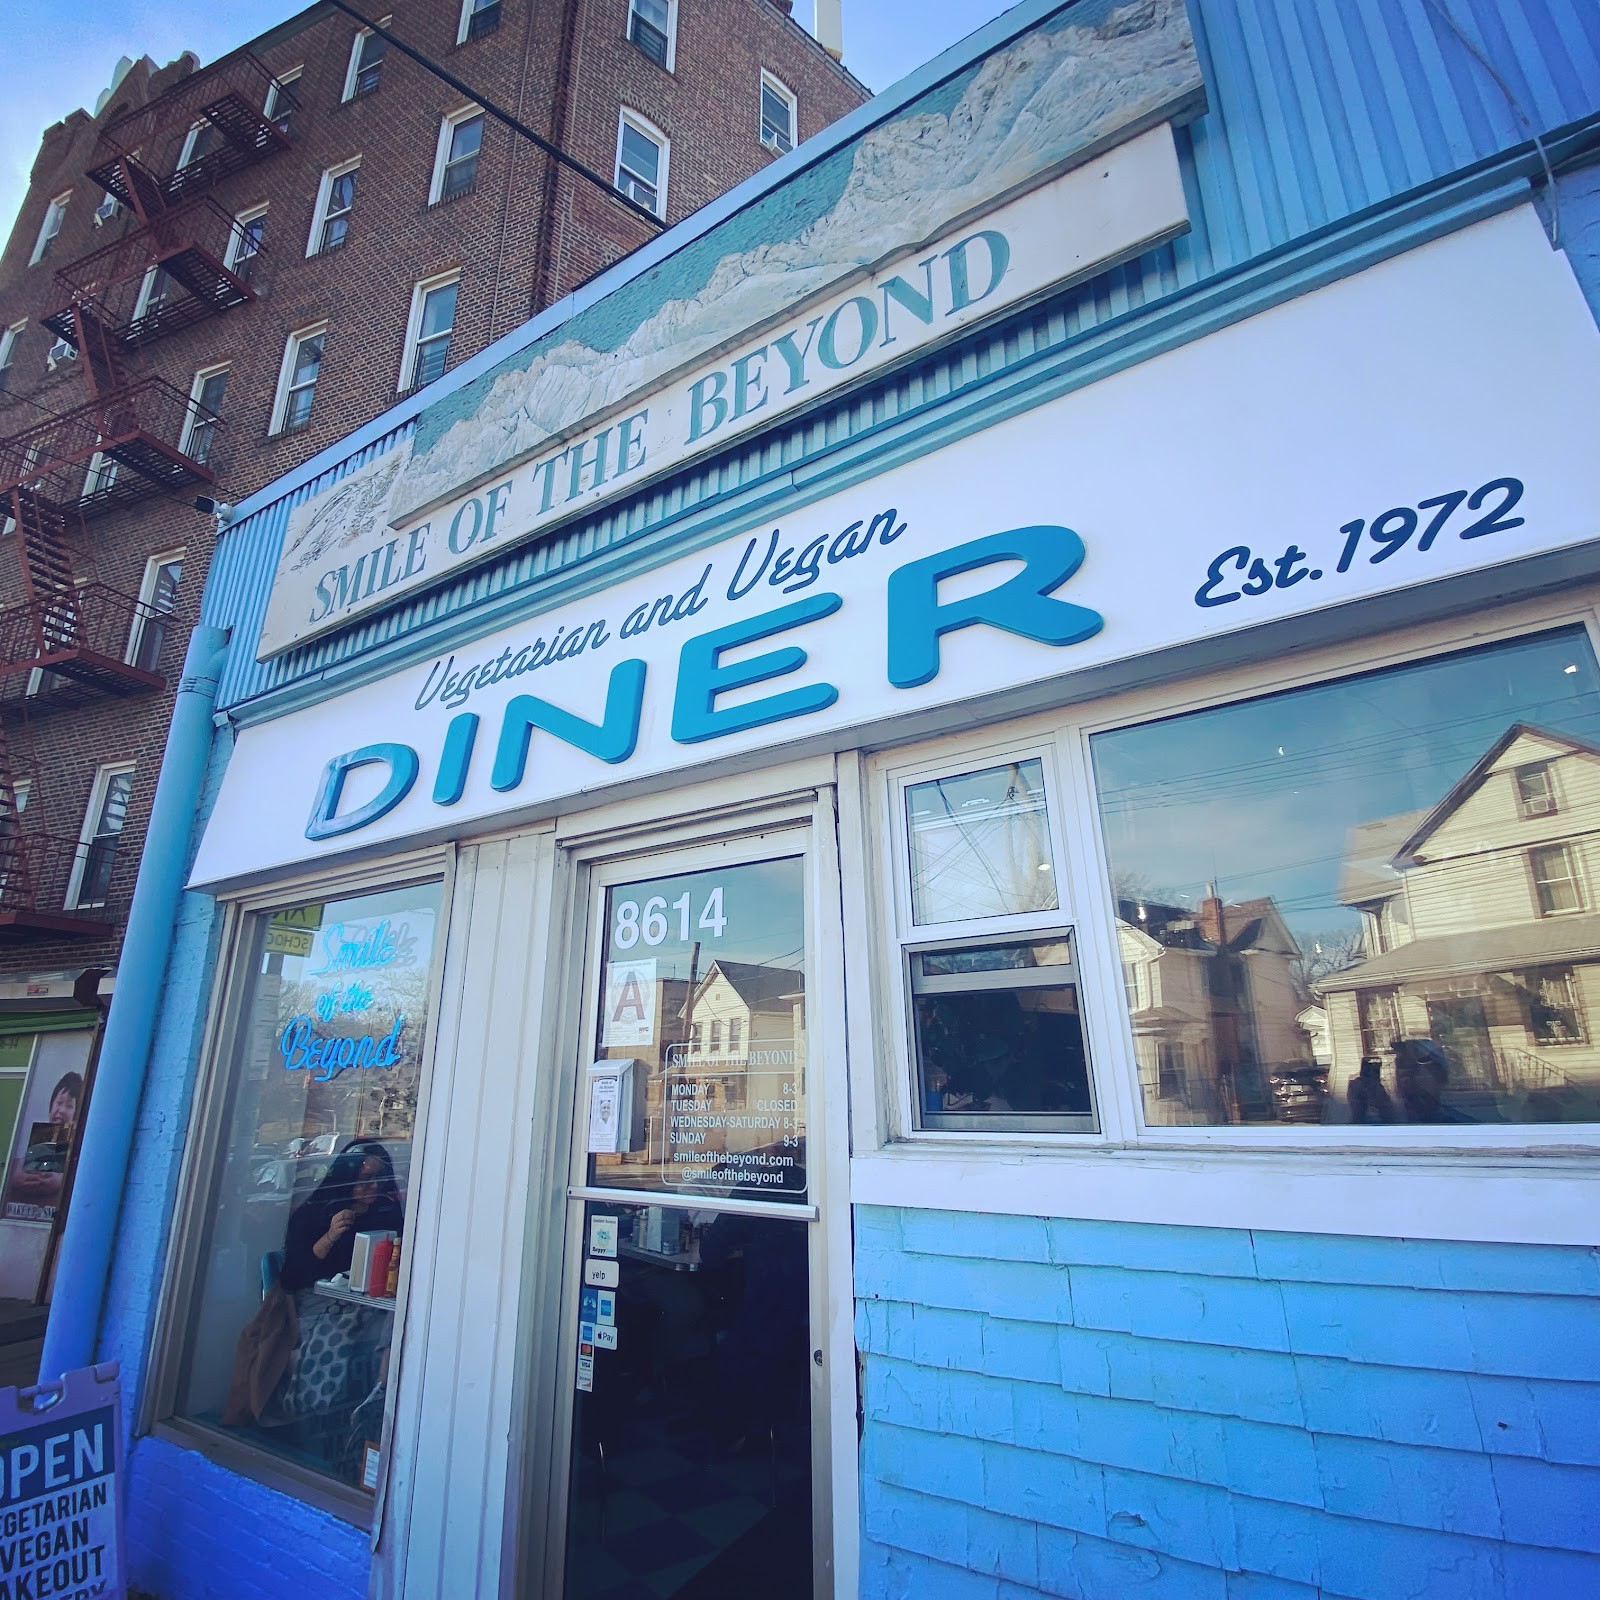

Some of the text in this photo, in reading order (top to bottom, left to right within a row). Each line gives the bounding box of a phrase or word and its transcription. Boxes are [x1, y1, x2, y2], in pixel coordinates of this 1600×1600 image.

[308, 229, 1010, 625] SMILE OF THE BEYOND
[1195, 477, 1525, 608] Est. 1972
[415, 508, 907, 711] Vegetarian and Vegan
[303, 524, 1104, 842] DINER
[614, 886, 728, 950] 8614
[309, 919, 396, 976] Smile
[316, 979, 375, 1023] of the
[612, 971, 646, 1022] A
[281, 1014, 406, 1082] Beyond
[750, 1049, 797, 1066] BEYOND
[671, 1082, 798, 1096] MONDAY 8-3
[671, 1099, 798, 1112] TUESDAY CLOSED
[670, 1116, 781, 1129] WEDNESDAY-SATURDAY
[670, 1132, 799, 1147] SUNDAY 9-3
[673, 1151, 794, 1167] smileofthebeyond.com
[682, 1166, 784, 1184] @smileofthebeyond
[592, 1269, 606, 1280] yelp
[602, 1331, 615, 1343] Pay
[0, 1423, 104, 1501] PEN
[0, 1481, 107, 1540] GETARIAN
[0, 1544, 105, 1600] AKEOUT
